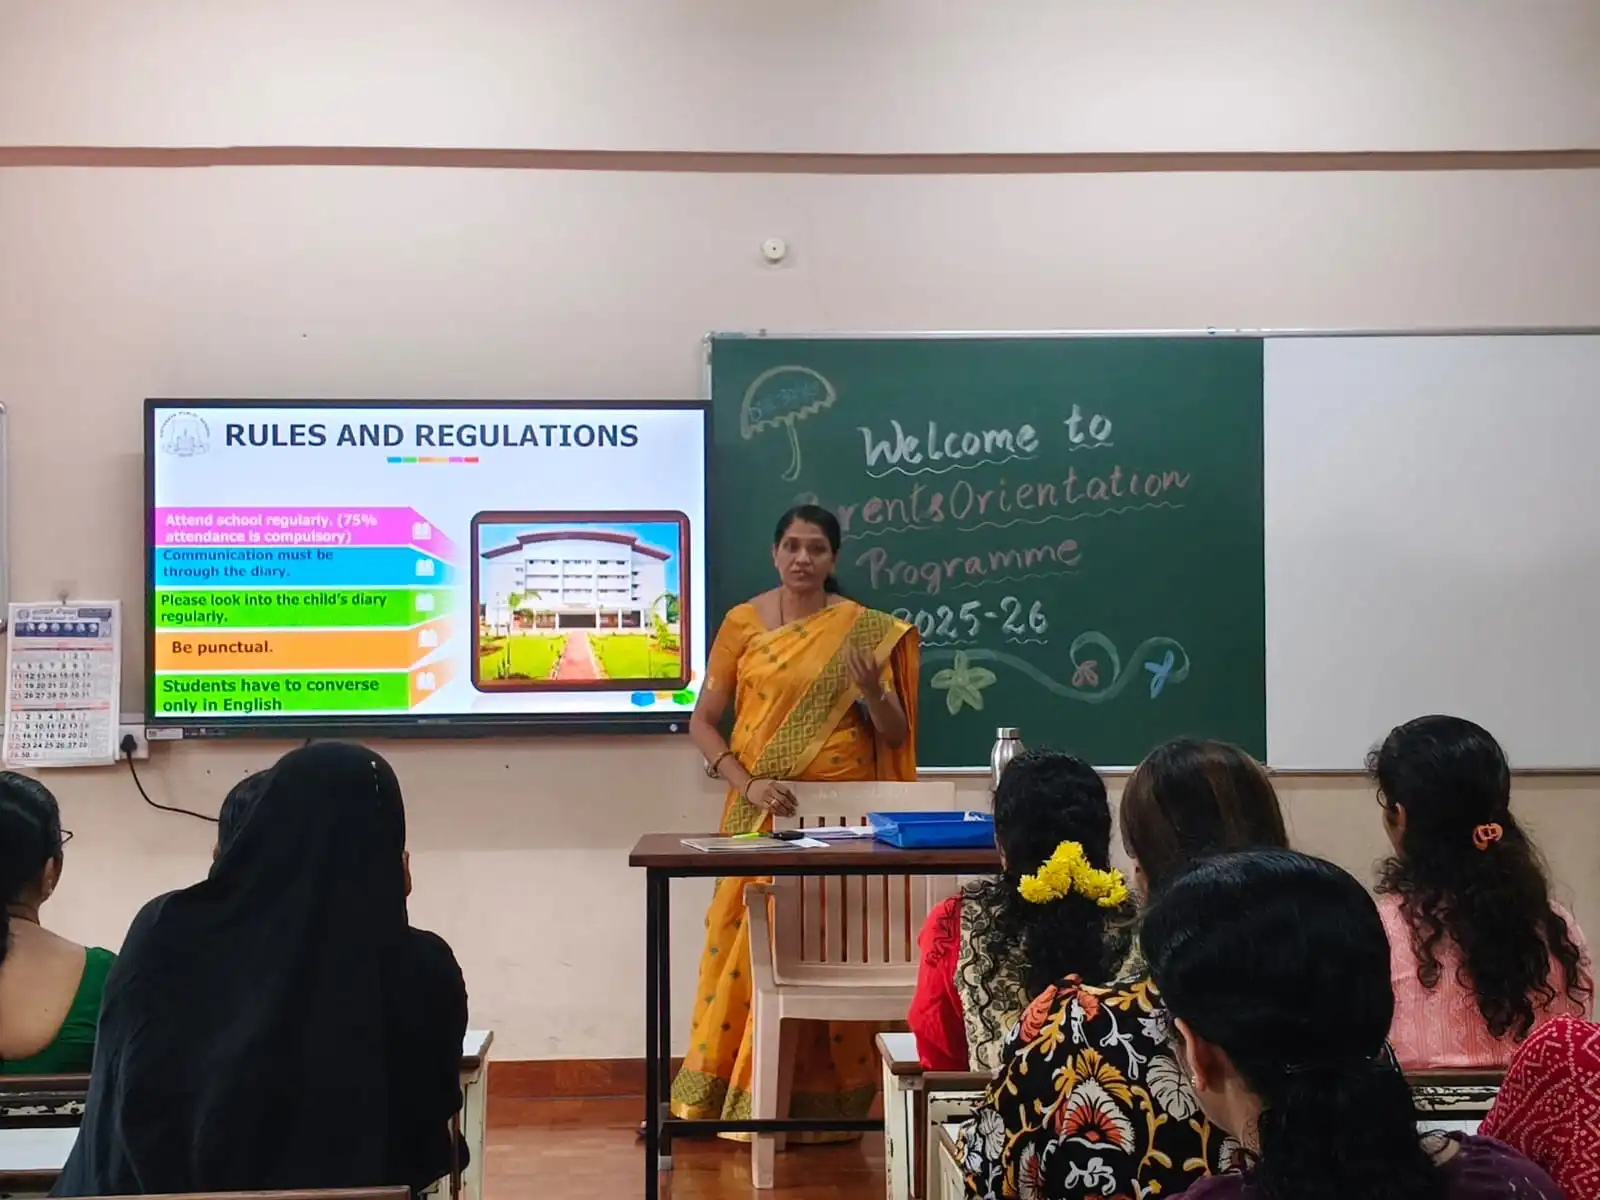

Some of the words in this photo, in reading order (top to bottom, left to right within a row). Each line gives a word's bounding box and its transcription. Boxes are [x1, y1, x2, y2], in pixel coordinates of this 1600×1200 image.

[226, 423, 327, 447] RULES
[336, 423, 404, 447] AND
[415, 423, 639, 448] REGULATIONS
[856, 419, 1040, 467] Welcome
[1063, 403, 1113, 444] to
[793, 482, 945, 532] rents
[950, 465, 1191, 521] Orientation
[165, 513, 213, 527] Attend
[216, 513, 262, 527] school
[266, 513, 333, 529] regularly.
[337, 513, 378, 528] (75%
[165, 529, 245, 543] attendance
[248, 529, 259, 543] is
[263, 529, 352, 545] compulsory)
[163, 548, 273, 561] Communication
[277, 548, 313, 561] must
[316, 548, 334, 561] be
[163, 566, 219, 580] through
[223, 565, 246, 578] the
[250, 565, 290, 581] diary.
[856, 539, 1082, 596] Programme
[161, 594, 207, 607] Please
[211, 593, 240, 607] look
[244, 593, 272, 607] into
[276, 593, 300, 606] the
[303, 593, 348, 606] child's
[352, 593, 387, 608] diary
[161, 610, 228, 625] regularly.
[172, 641, 192, 654] Be
[198, 640, 274, 656] punctual.
[163, 679, 236, 693] Students
[240, 678, 281, 692] have
[285, 679, 302, 692] to
[306, 679, 379, 692] converse
[163, 699, 197, 714] only
[202, 698, 218, 712] in
[223, 698, 283, 715] English
